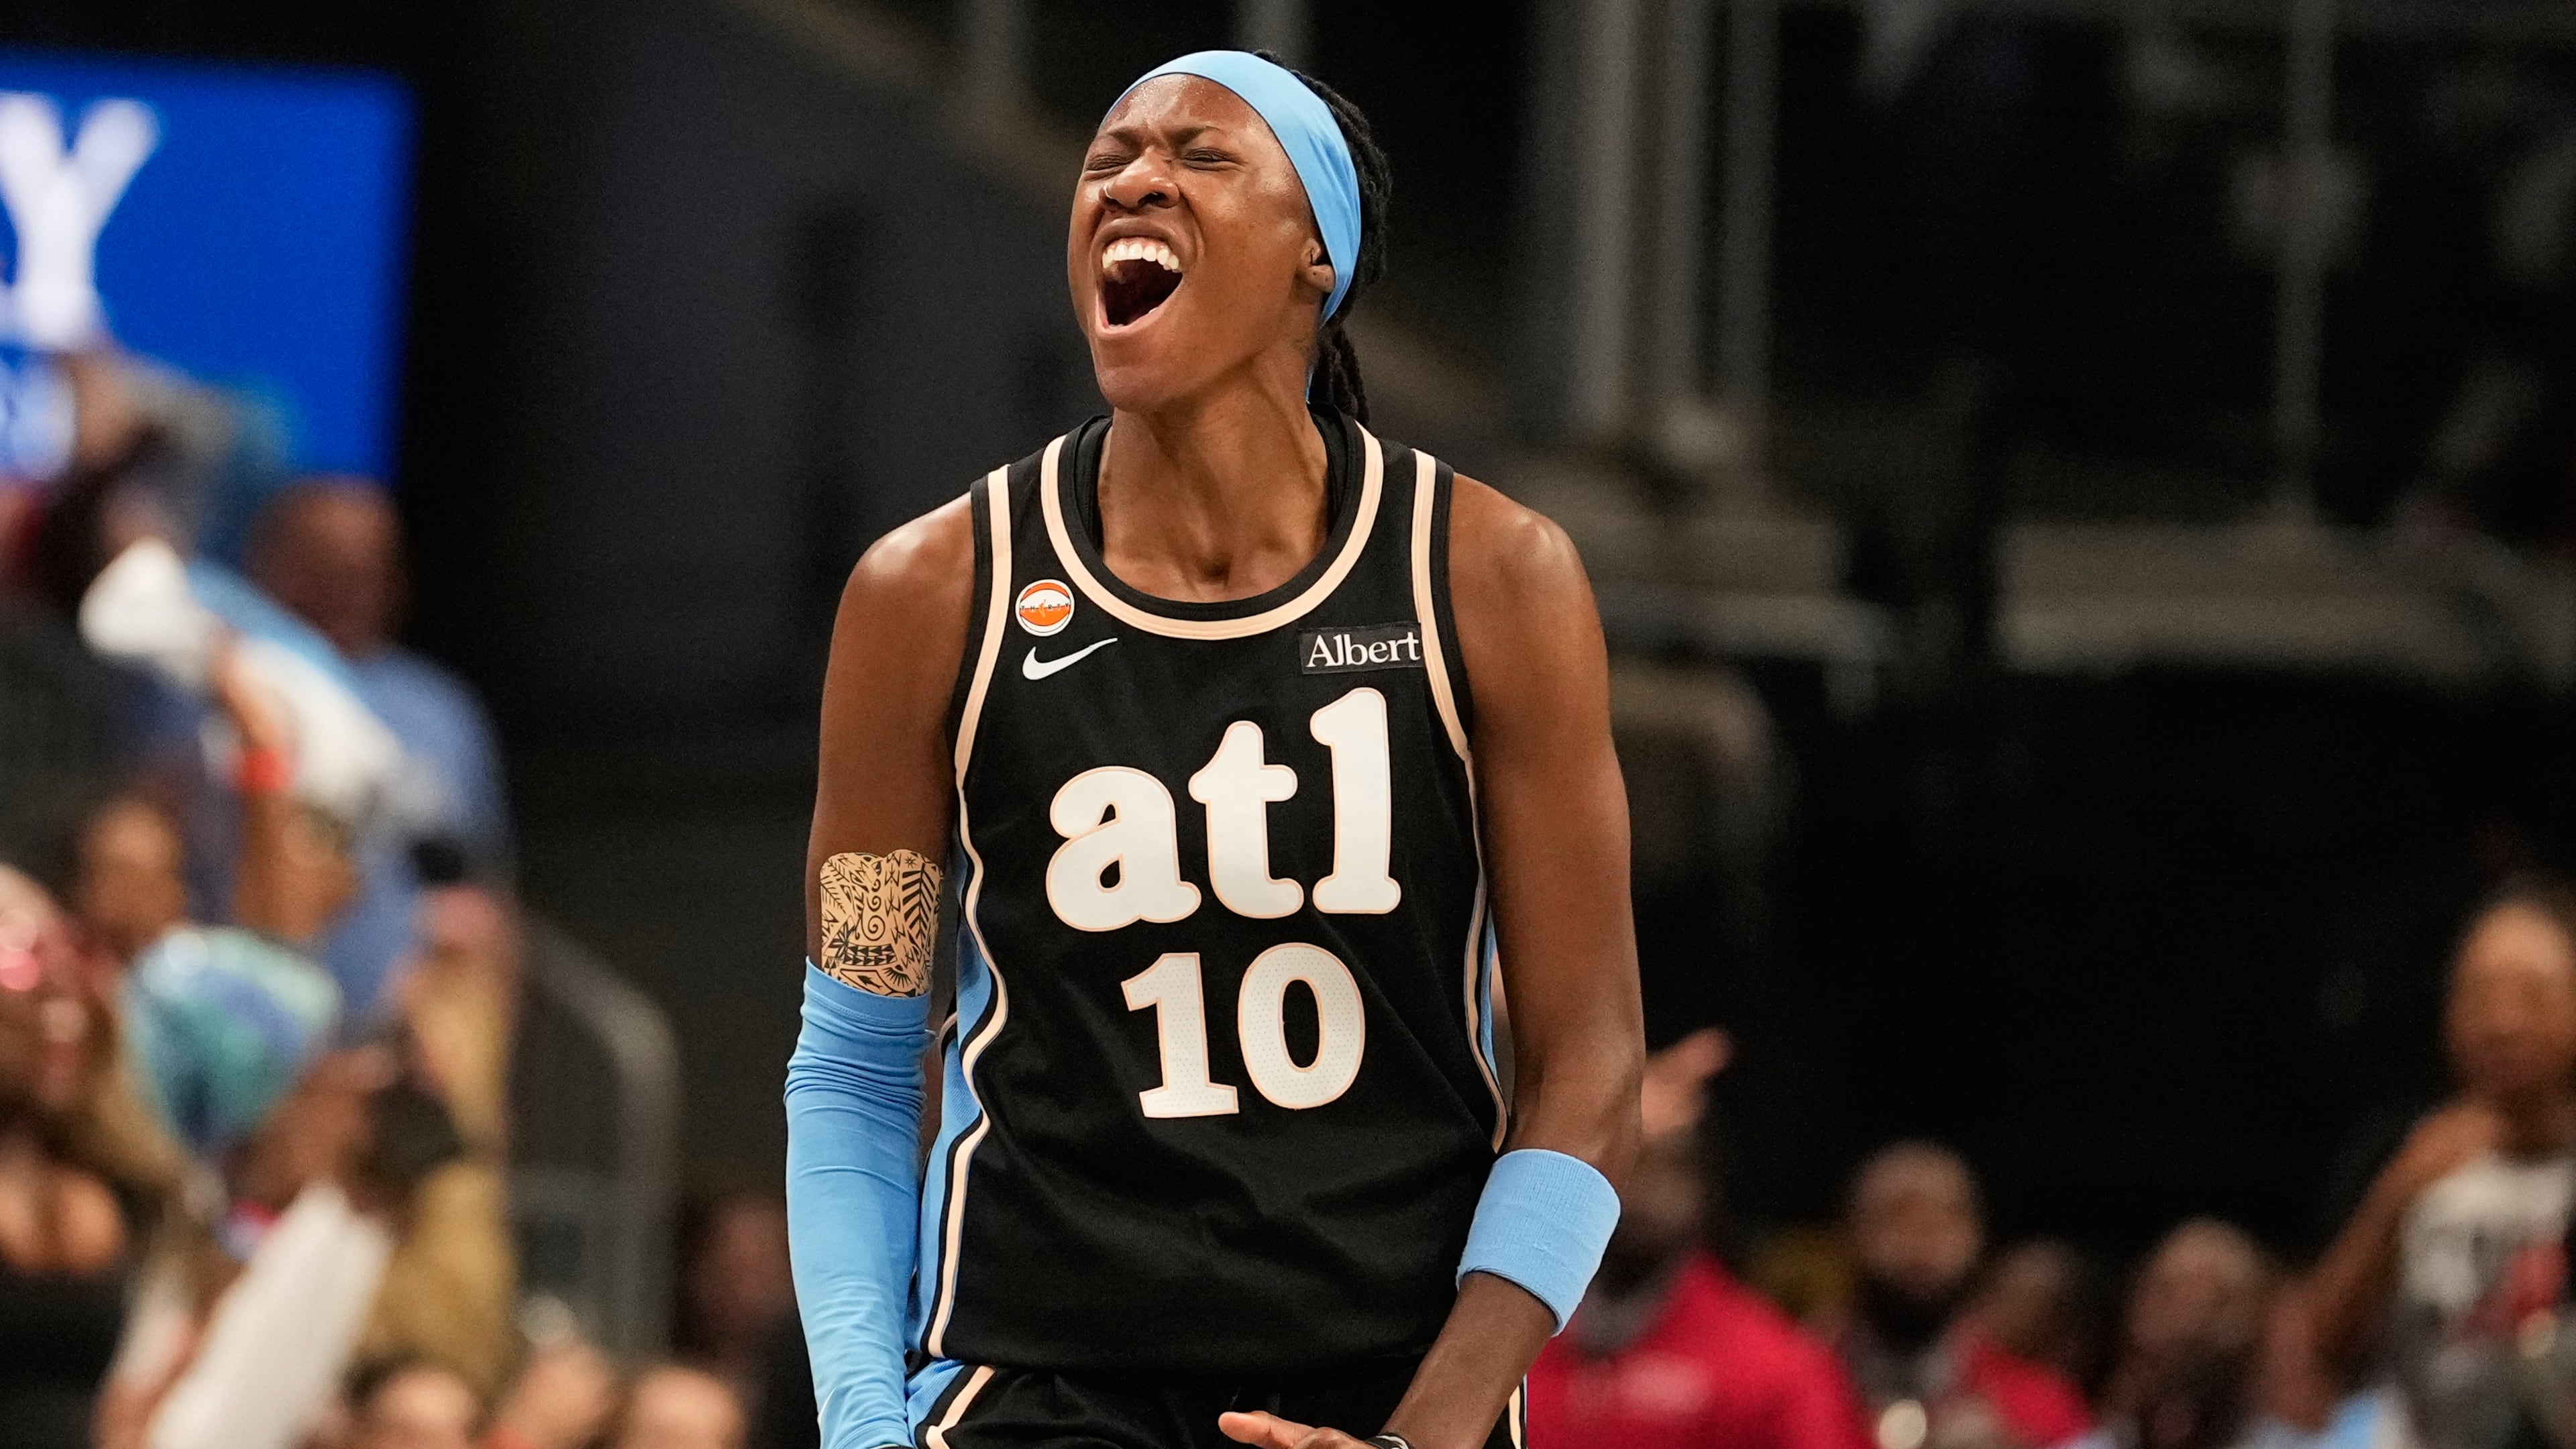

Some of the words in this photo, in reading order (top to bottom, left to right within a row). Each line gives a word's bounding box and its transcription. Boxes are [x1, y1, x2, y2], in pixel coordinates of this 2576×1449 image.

[1305, 631, 1421, 667] Albert
[1045, 686, 1401, 932] atl
[1120, 942, 1366, 1119] 10
